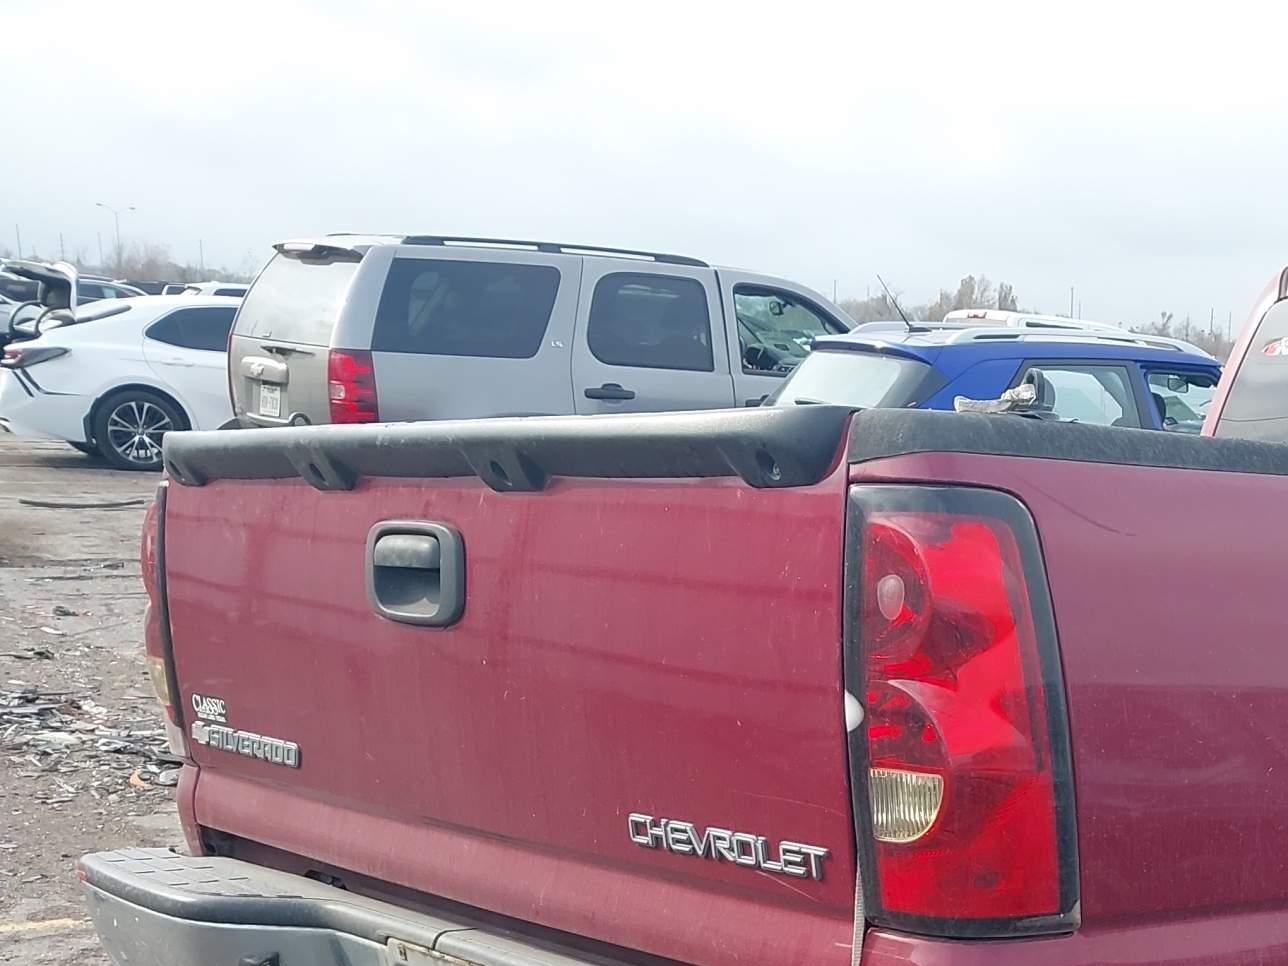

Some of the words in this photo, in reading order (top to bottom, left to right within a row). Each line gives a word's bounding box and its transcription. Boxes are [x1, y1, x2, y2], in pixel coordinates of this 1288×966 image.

[192, 693, 226, 716] CLASSIC
[208, 723, 301, 769] SILVERADO
[628, 812, 830, 881] CHEVROLET
